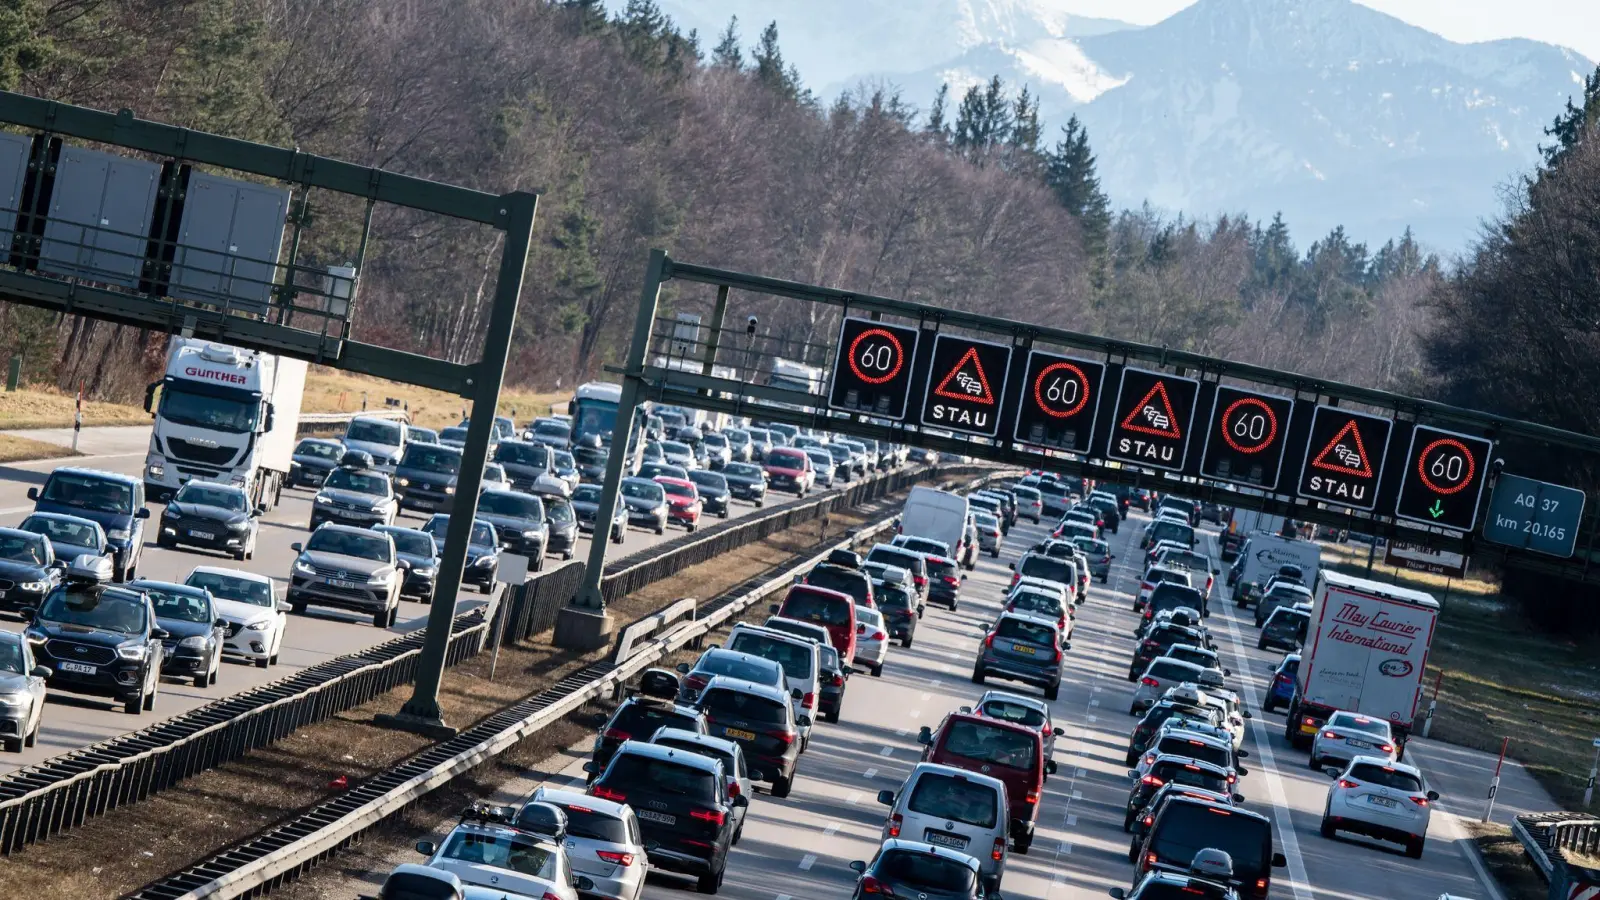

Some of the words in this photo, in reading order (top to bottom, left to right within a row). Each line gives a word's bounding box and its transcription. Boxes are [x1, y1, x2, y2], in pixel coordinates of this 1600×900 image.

[861, 343, 892, 371] 60
[1047, 377, 1078, 405] 60
[932, 404, 987, 427] STAU
[1234, 412, 1265, 440] 60
[1119, 438, 1174, 461] STAU
[1431, 453, 1463, 481] 60
[1310, 475, 1365, 500] STAU
[1514, 493, 1535, 508] AQ
[1541, 498, 1559, 513] 37
[1495, 513, 1518, 530] km
[1523, 520, 1566, 541] 20.165
[1333, 603, 1369, 627] May
[1369, 611, 1421, 636] Courier
[1327, 624, 1413, 656] International
